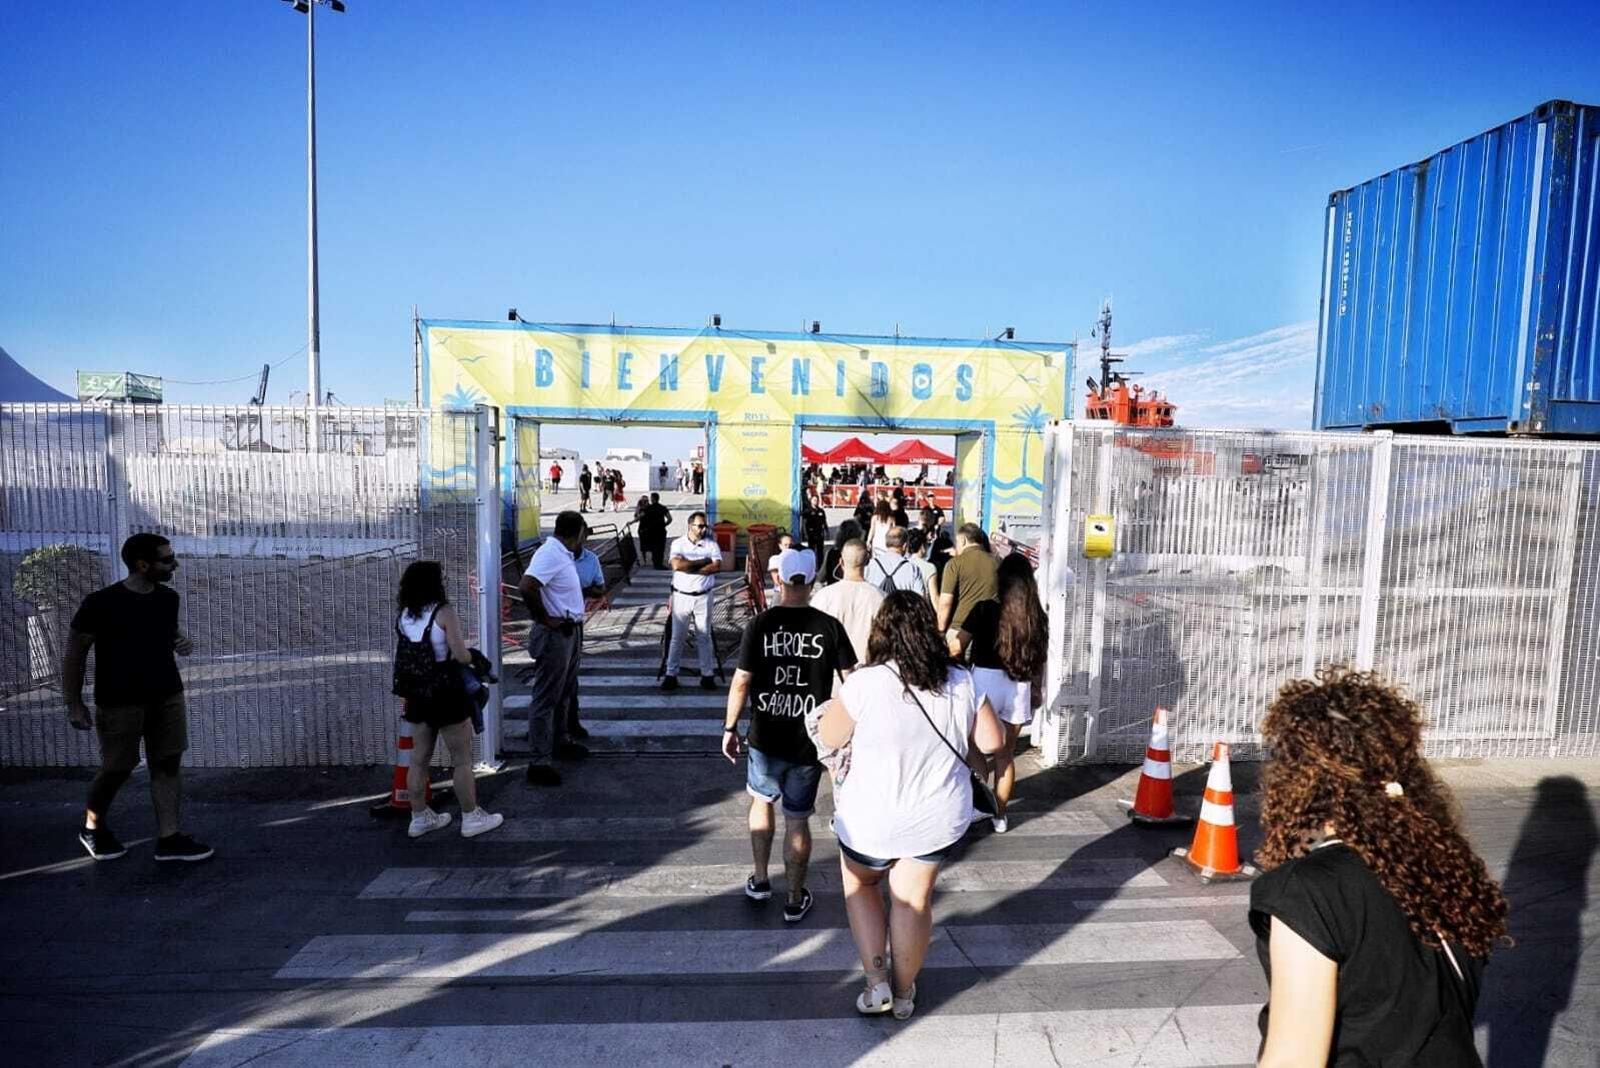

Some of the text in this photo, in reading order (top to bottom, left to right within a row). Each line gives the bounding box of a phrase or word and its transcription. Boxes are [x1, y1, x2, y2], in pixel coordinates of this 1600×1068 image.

[535, 348, 973, 402] BIENVENIDOS
[763, 625, 824, 659] HÉROES
[774, 665, 809, 687] DEL
[757, 690, 817, 718] SÁBADO
